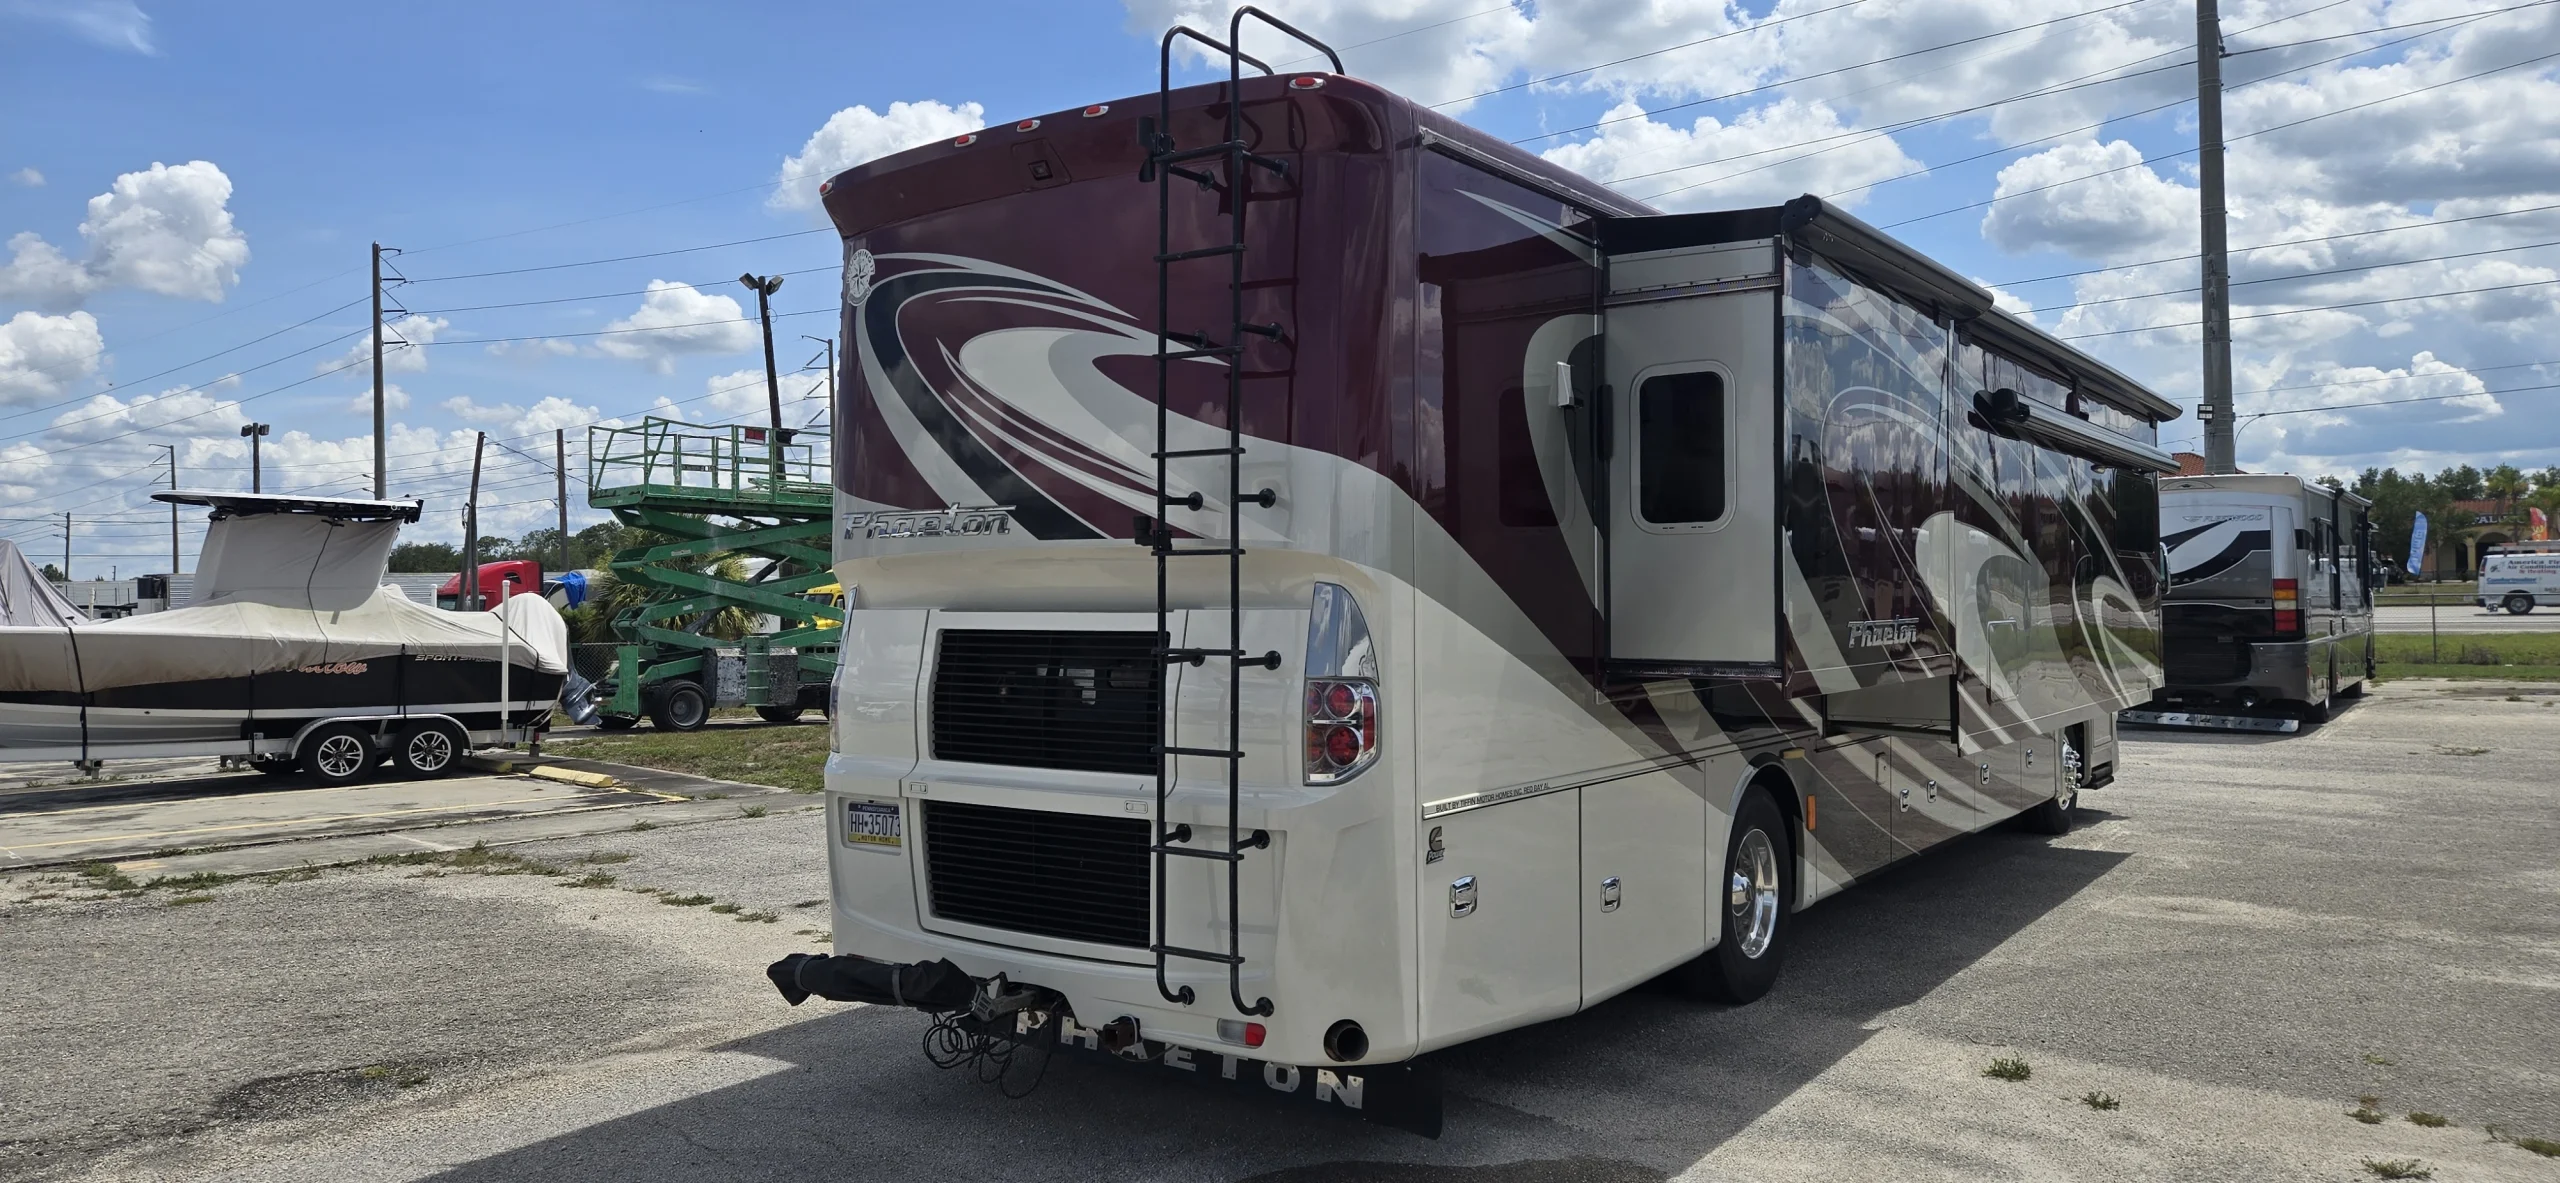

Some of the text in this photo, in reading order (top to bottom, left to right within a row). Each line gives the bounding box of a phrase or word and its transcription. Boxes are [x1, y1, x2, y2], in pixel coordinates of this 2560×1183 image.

[842, 502, 1017, 540] Phaeton
[1848, 615, 1919, 648] Phaeton
[1436, 802, 1452, 813] BUILT
[1452, 801, 1460, 809] BY
[1460, 797, 1476, 807] TIFFIN
[1476, 793, 1495, 804] MOTOR
[1495, 790, 1513, 800] HOMES
[1523, 786, 1534, 794] RED
[1534, 783, 1543, 792] BAY
